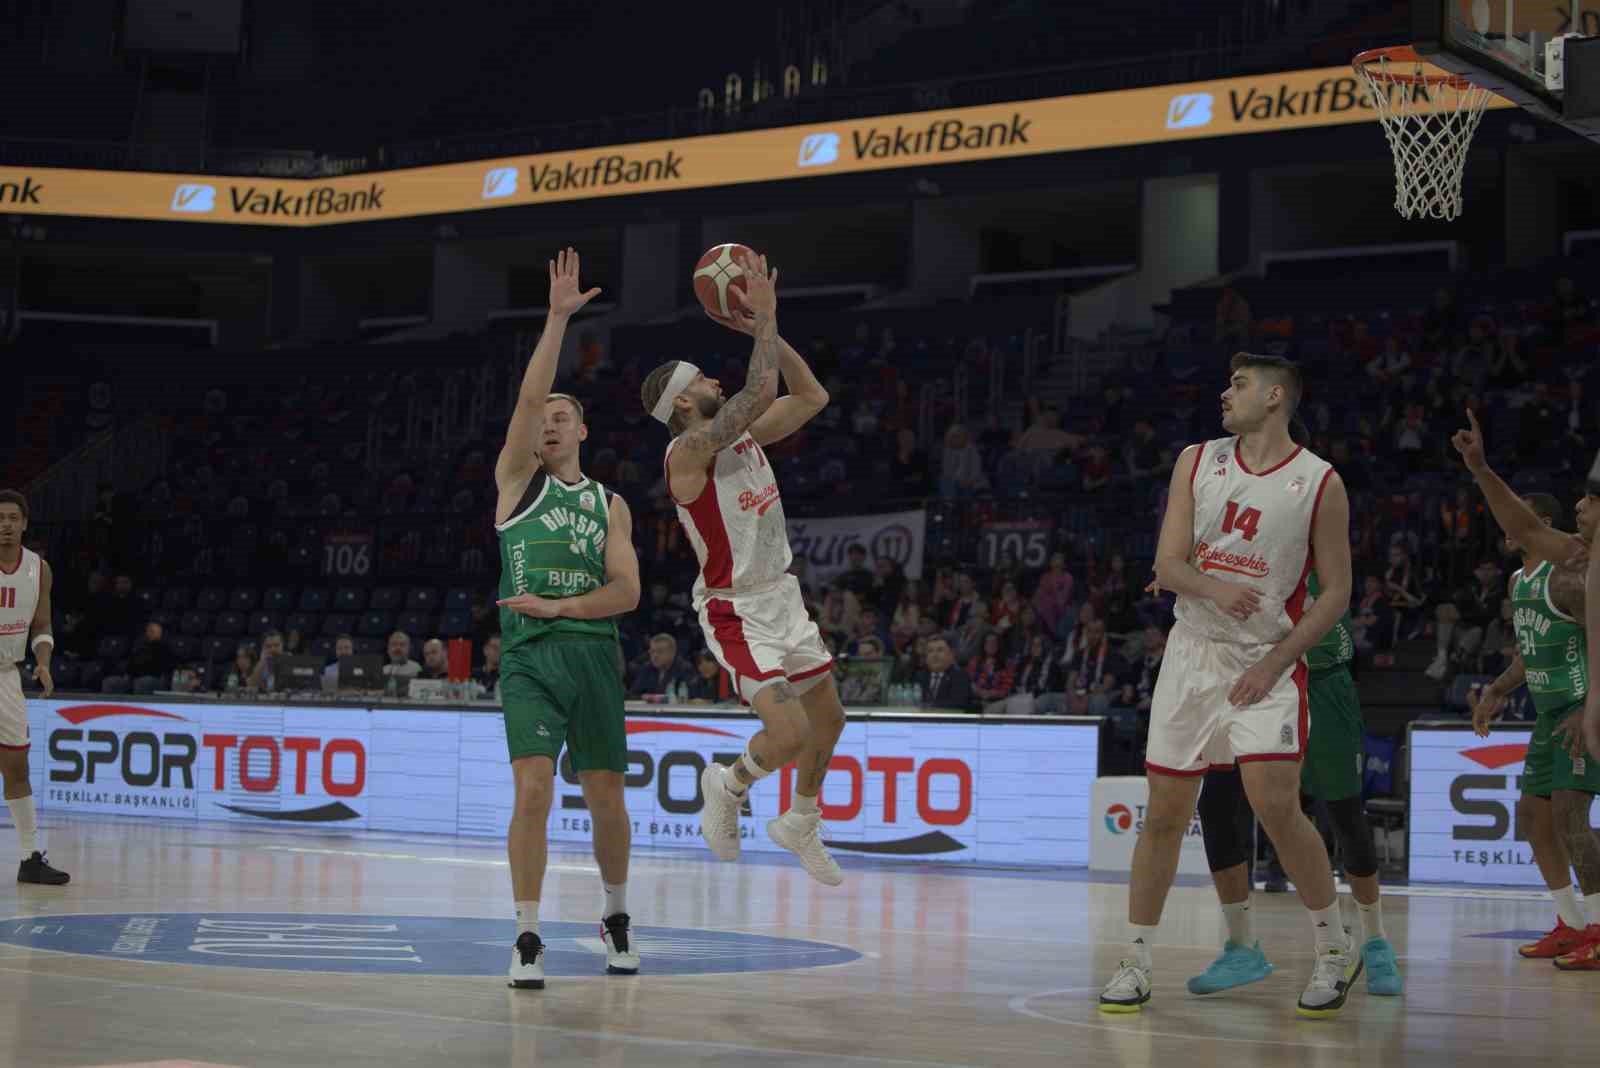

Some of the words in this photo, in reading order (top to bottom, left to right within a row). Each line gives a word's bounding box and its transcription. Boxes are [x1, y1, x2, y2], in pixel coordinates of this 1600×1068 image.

[852, 114, 1032, 160] VakıfBank
[528, 151, 682, 194] VakıfBank
[229, 184, 385, 217] VakıfBank
[1221, 500, 1262, 542] 14
[324, 544, 370, 576] 106
[511, 538, 529, 595] Teknik
[985, 532, 1047, 568] 105
[50, 729, 198, 789] SPOR
[203, 734, 366, 797] TOTO
[50, 789, 109, 804] TEŞKİLAT
